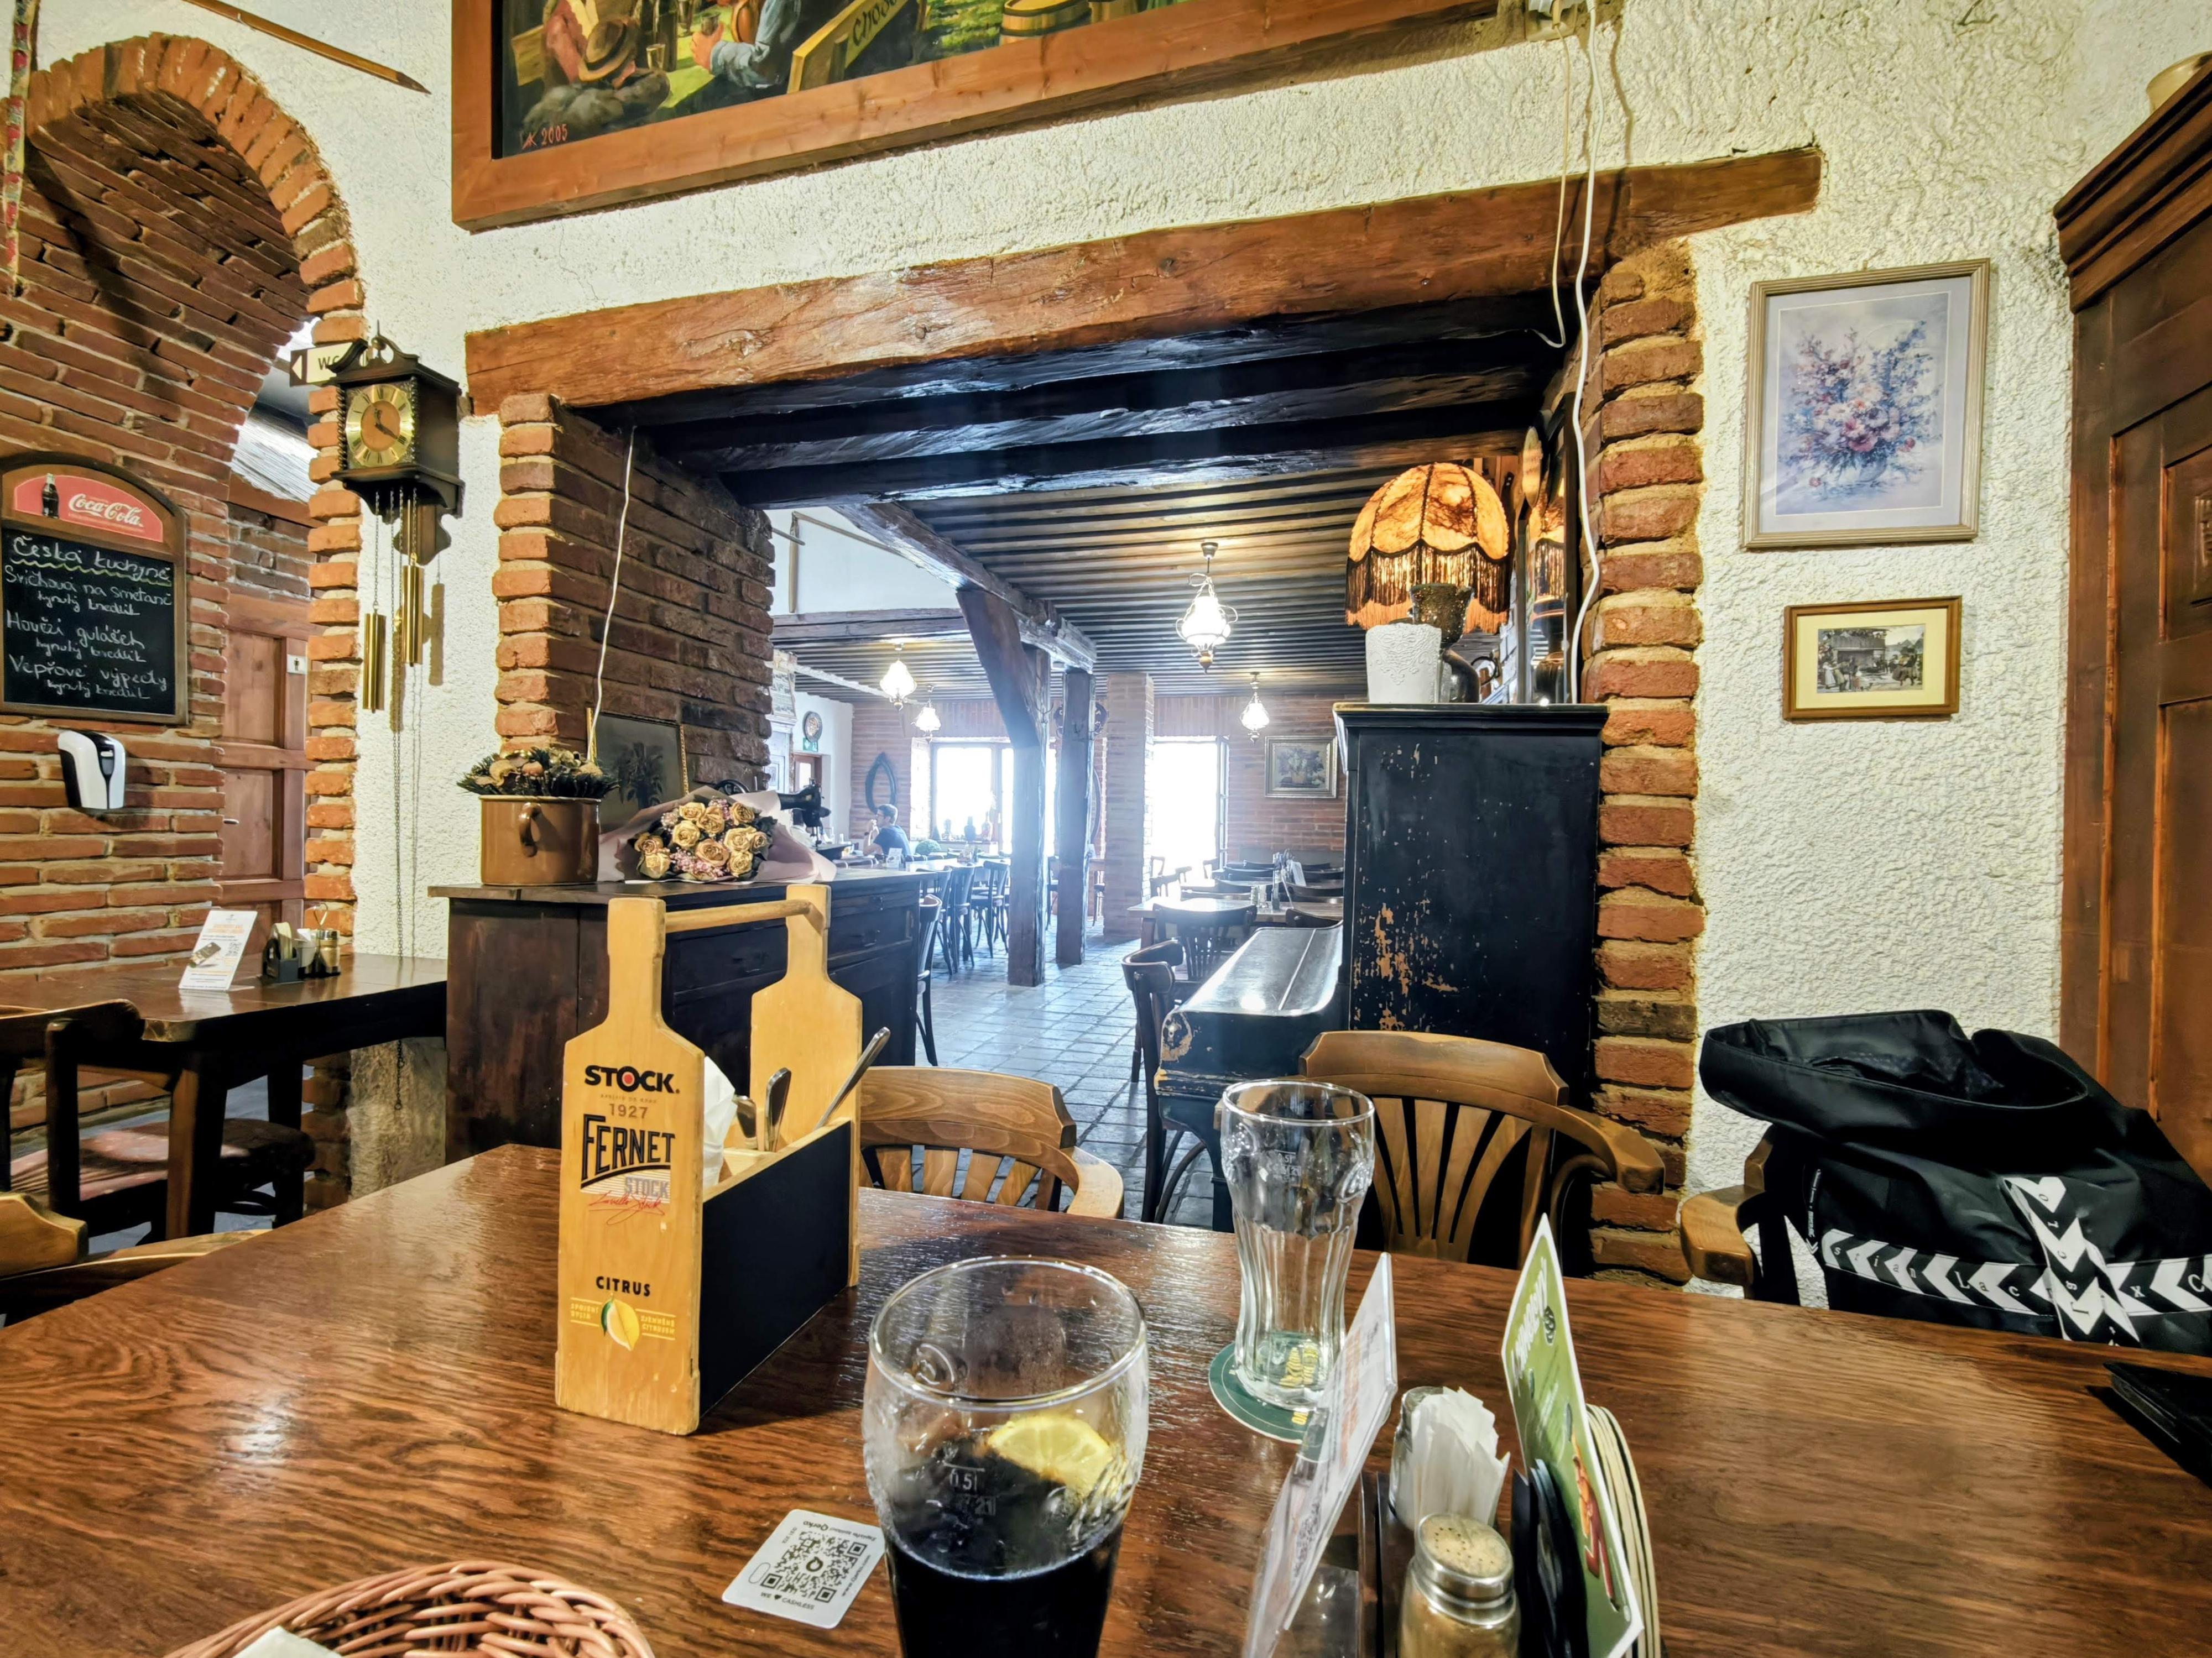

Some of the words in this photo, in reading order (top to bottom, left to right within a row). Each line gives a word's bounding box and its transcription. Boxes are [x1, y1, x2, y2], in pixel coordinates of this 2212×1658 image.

[541, 123, 567, 144] 2005
[68, 493, 144, 527] Coca-Cola
[83, 584, 107, 597] na
[609, 1103, 648, 1120] 1927
[581, 1113, 676, 1182] FERNET
[625, 1176, 670, 1199] STOCK
[596, 1276, 651, 1296] CITRUS
